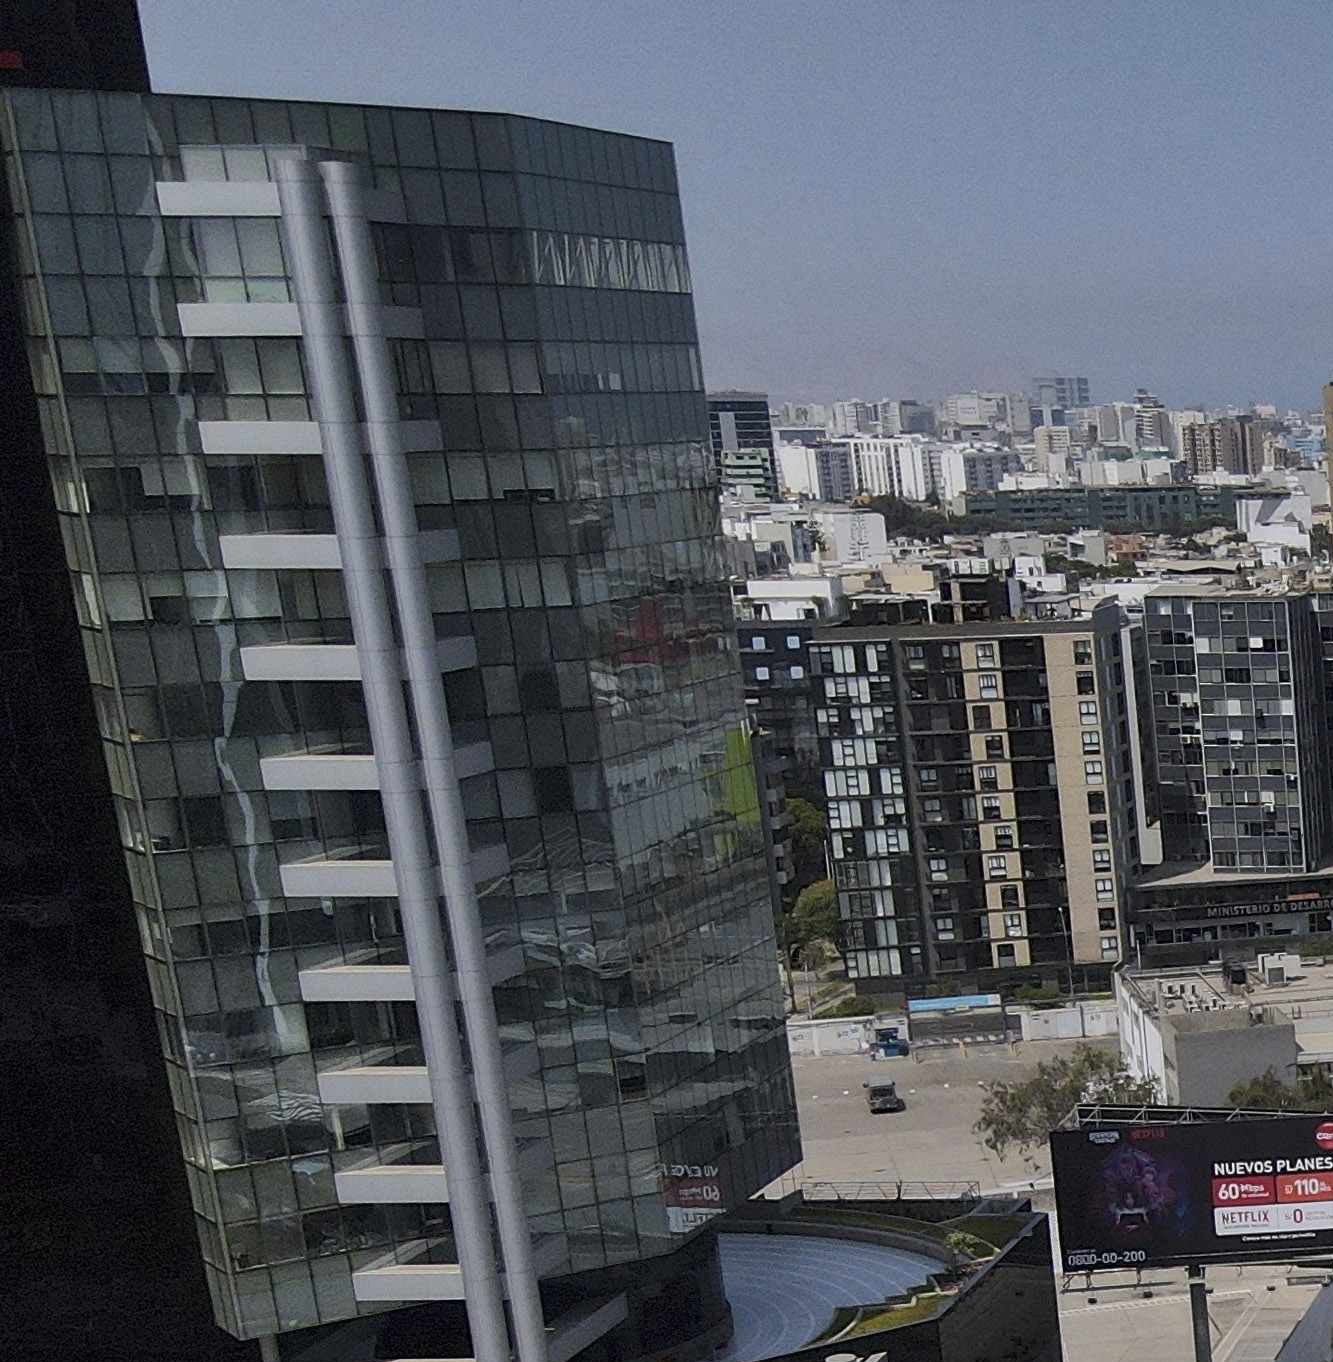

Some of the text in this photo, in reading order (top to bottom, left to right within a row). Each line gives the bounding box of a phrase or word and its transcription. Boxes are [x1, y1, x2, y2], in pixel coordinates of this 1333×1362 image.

[1207, 905, 1271, 918] MINISTERIO
[1273, 903, 1288, 913] DE
[1214, 1156, 1333, 1176] NUEVOS PLANES
[1218, 1183, 1239, 1200] 60
[1294, 1178, 1319, 1196] 110
[1221, 1209, 1270, 1226] NETFLIX
[1293, 1208, 1303, 1224] 0
[1067, 1250, 1146, 1266] 0800-00-200
